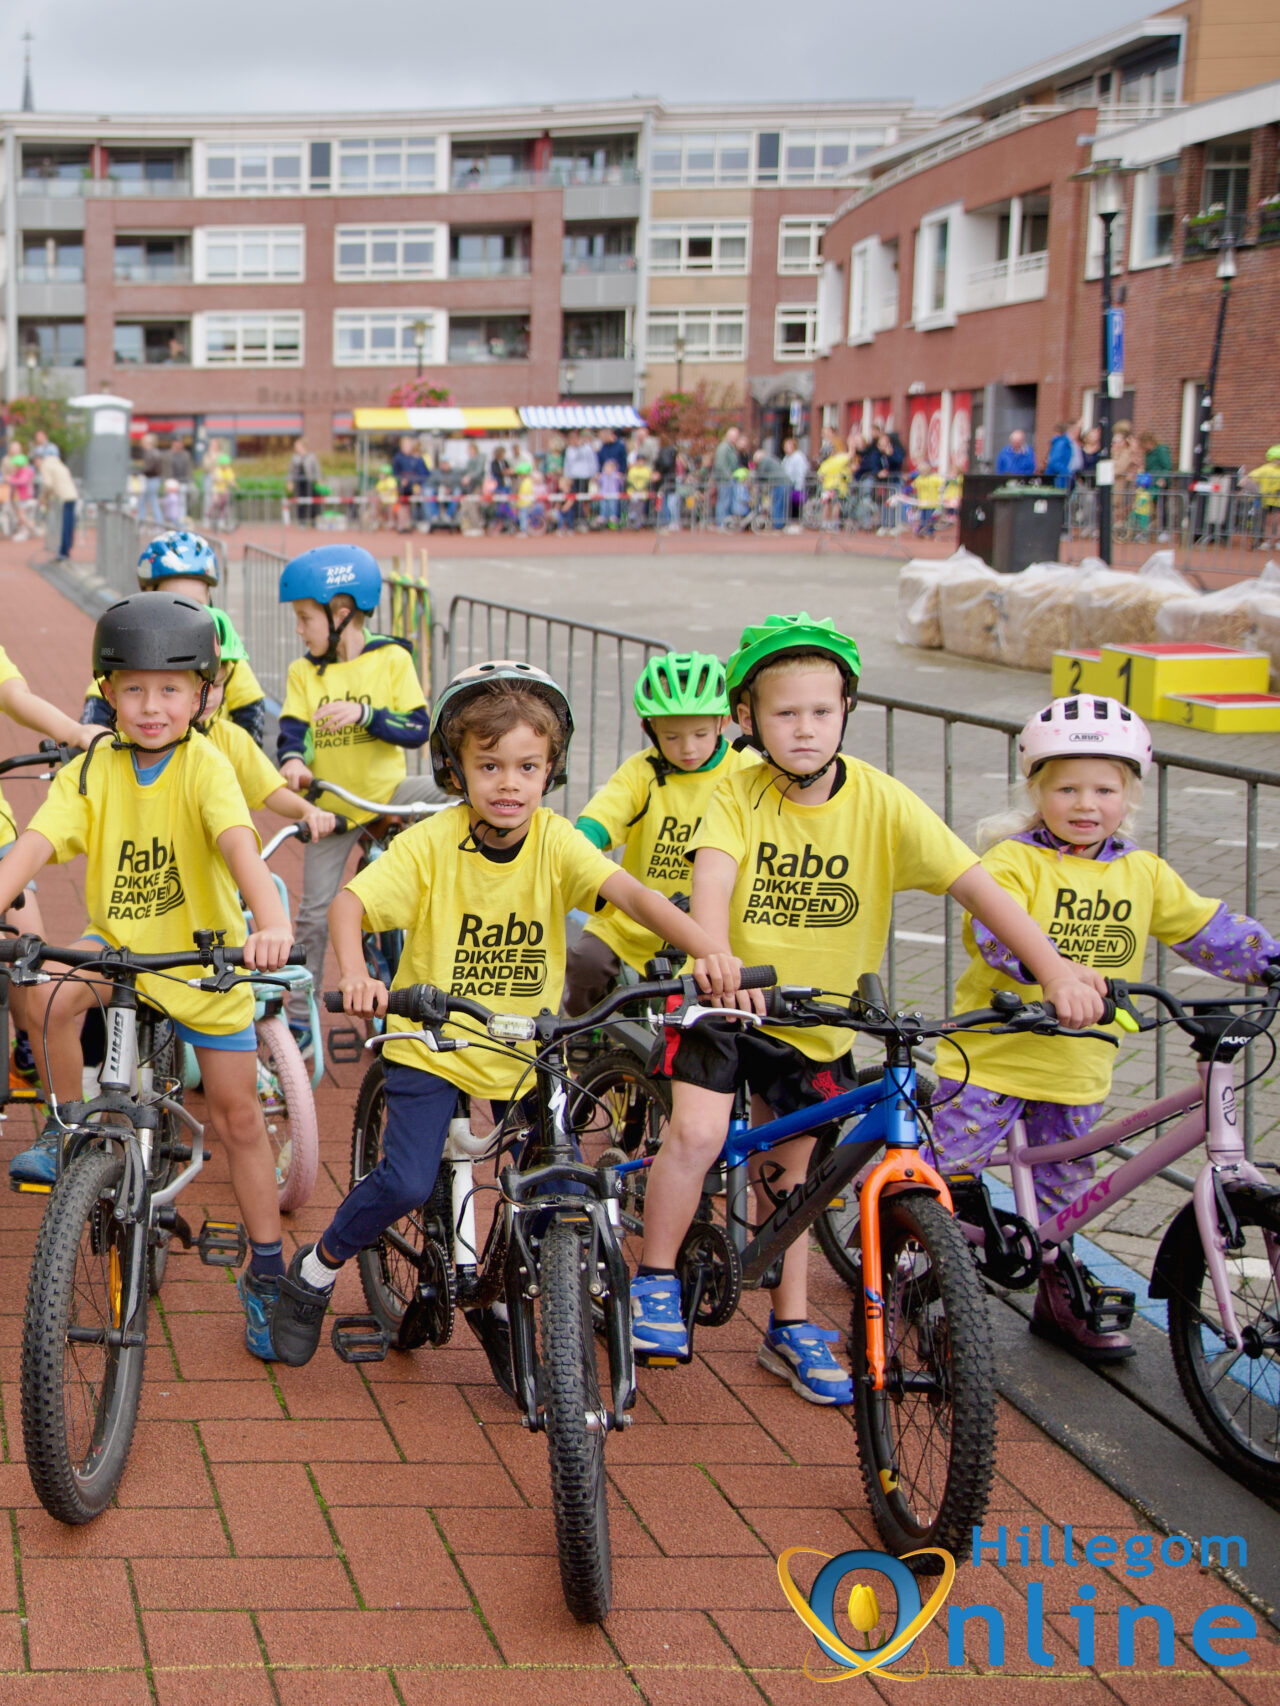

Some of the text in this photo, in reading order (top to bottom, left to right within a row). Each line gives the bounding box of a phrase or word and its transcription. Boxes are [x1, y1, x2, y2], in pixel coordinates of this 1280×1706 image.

[1070, 660, 1082, 695] 2
[1118, 658, 1132, 706] 1
[315, 736, 350, 749] RACE
[658, 816, 702, 842] Ra
[756, 842, 849, 879] Rabo
[114, 872, 160, 889] DIKKE
[647, 867, 690, 880] RACE
[111, 882, 171, 904] BANDEN
[752, 878, 813, 896] DIKKE
[108, 904, 152, 920] RACE
[748, 893, 837, 913] BANDEN
[1054, 888, 1132, 922] Rabo
[742, 910, 801, 928] RACE
[457, 912, 544, 947] Rabo
[1048, 922, 1101, 937] DIKKE
[454, 949, 518, 964] DIKKE
[452, 965, 539, 980] BANDEN
[450, 981, 507, 997] RACE
[110, 1011, 124, 1080] GIANT
[1220, 1036, 1251, 1044] PUKY
[773, 1156, 838, 1232] CUBE
[1056, 1168, 1118, 1232] PUKY
